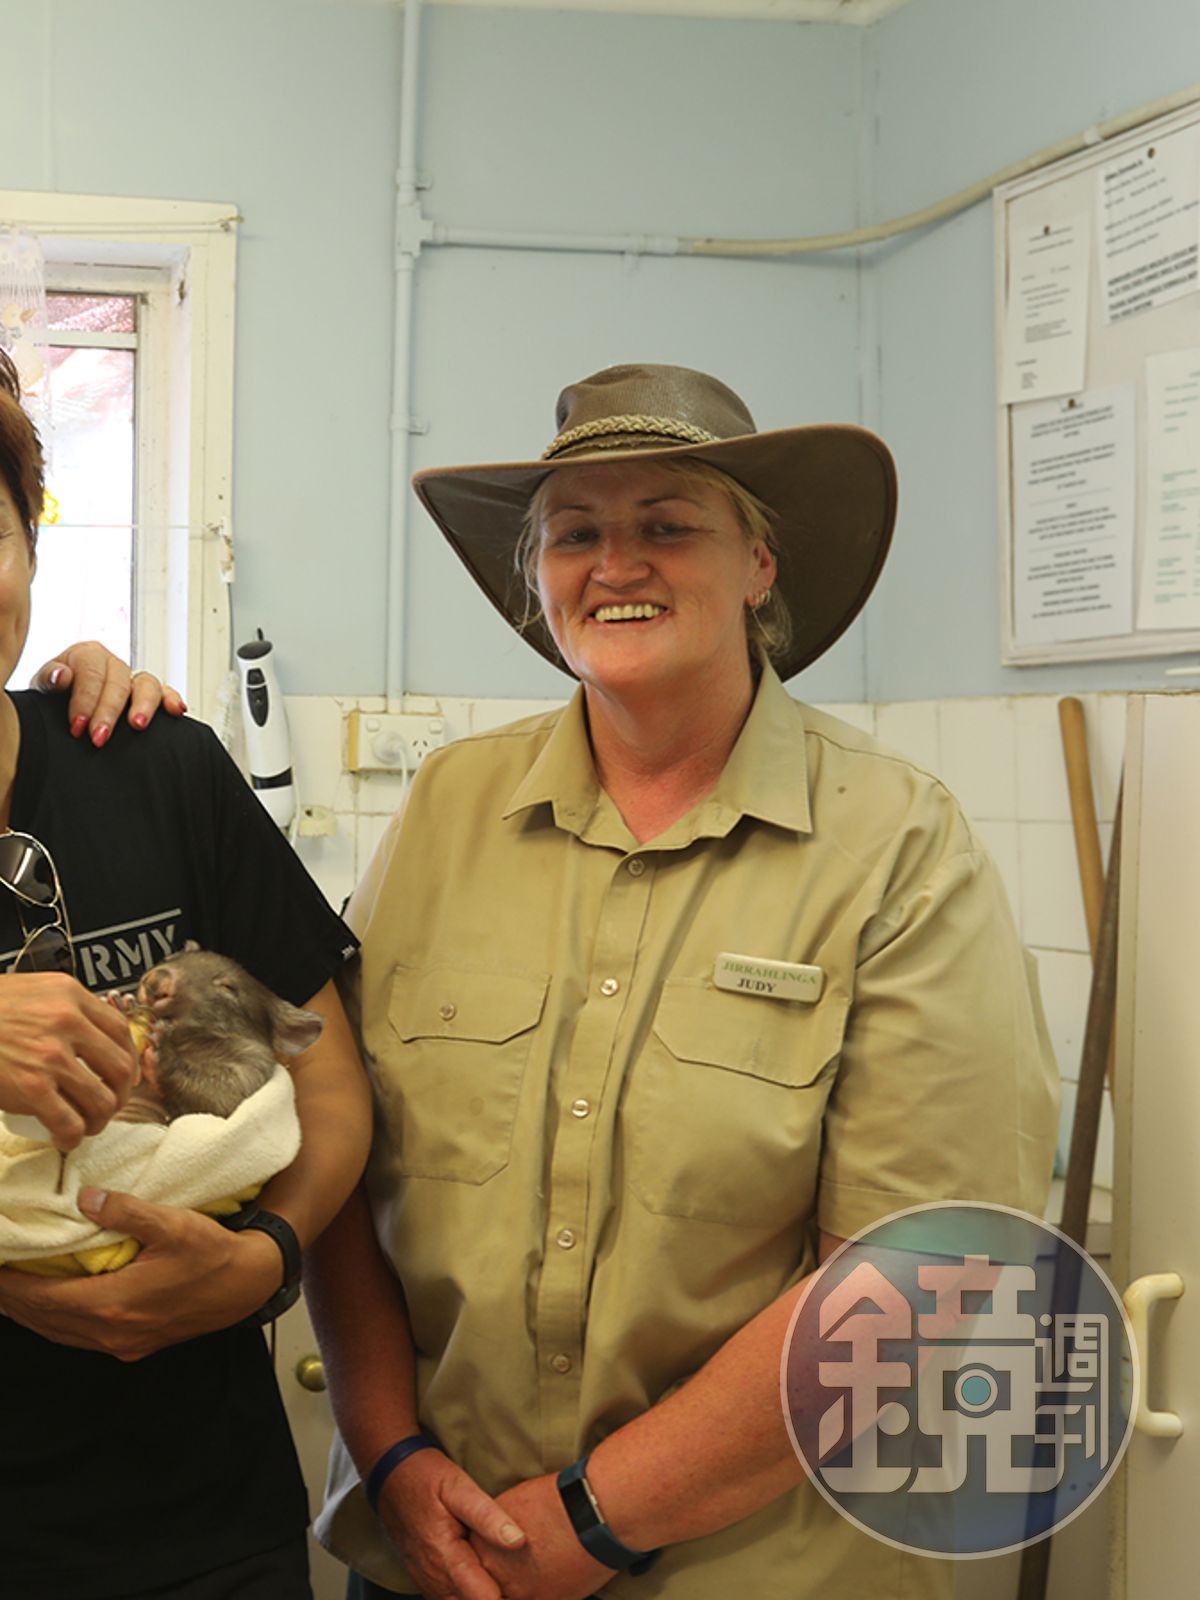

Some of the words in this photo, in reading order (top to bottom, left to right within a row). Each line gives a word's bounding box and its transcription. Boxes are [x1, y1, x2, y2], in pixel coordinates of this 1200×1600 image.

[78, 924, 175, 987] RMY
[723, 961, 816, 985] JIRRAHLINGA
[737, 978, 776, 993] JUDY
